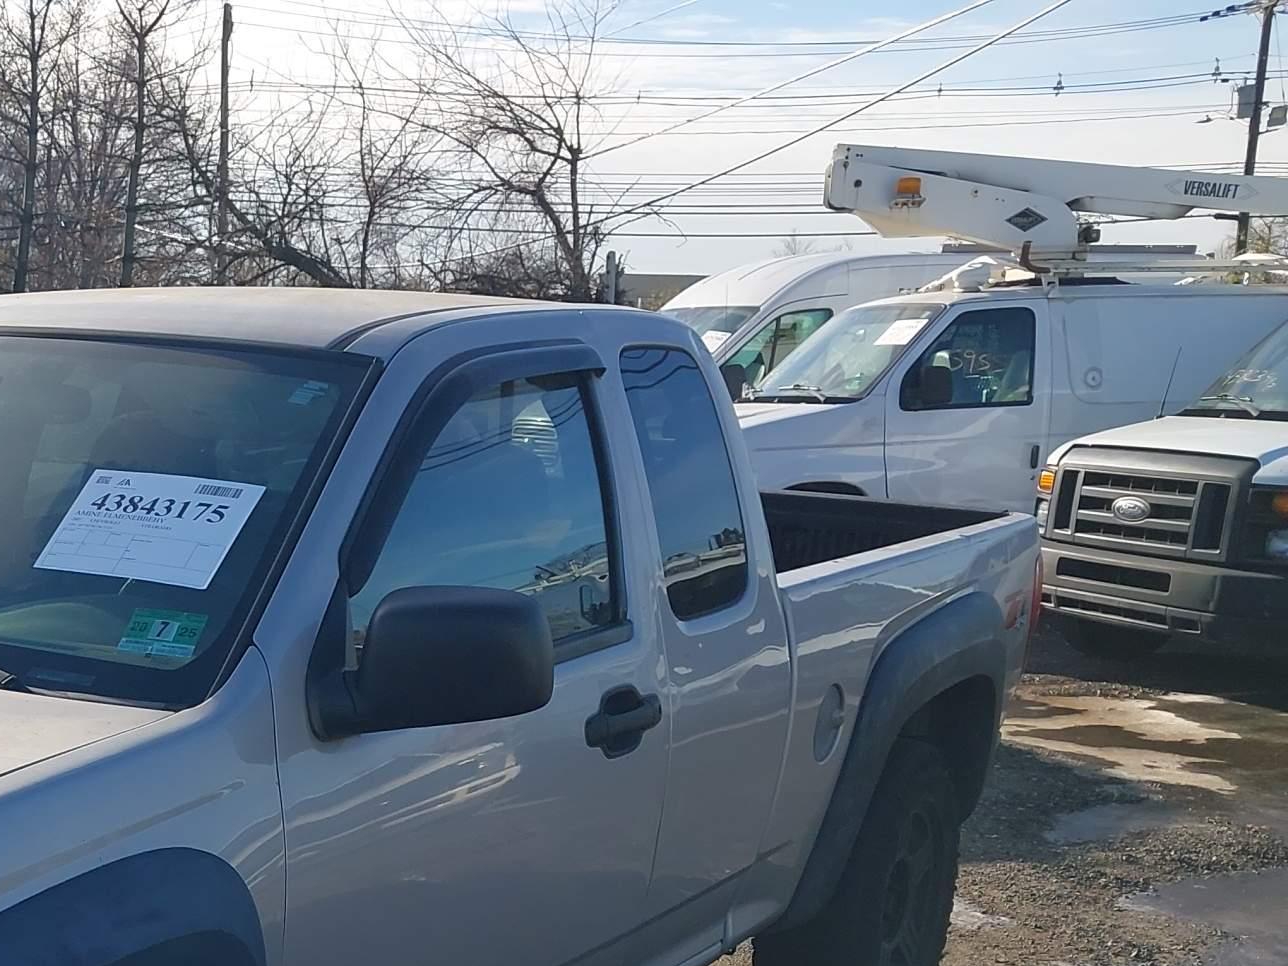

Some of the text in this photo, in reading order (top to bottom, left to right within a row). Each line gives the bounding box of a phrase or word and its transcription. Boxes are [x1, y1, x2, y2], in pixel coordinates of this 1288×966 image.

[1183, 180, 1241, 199] VERSALIFT
[90, 492, 231, 524] 43843175
[155, 620, 170, 638] 7
[178, 626, 198, 638] 25
